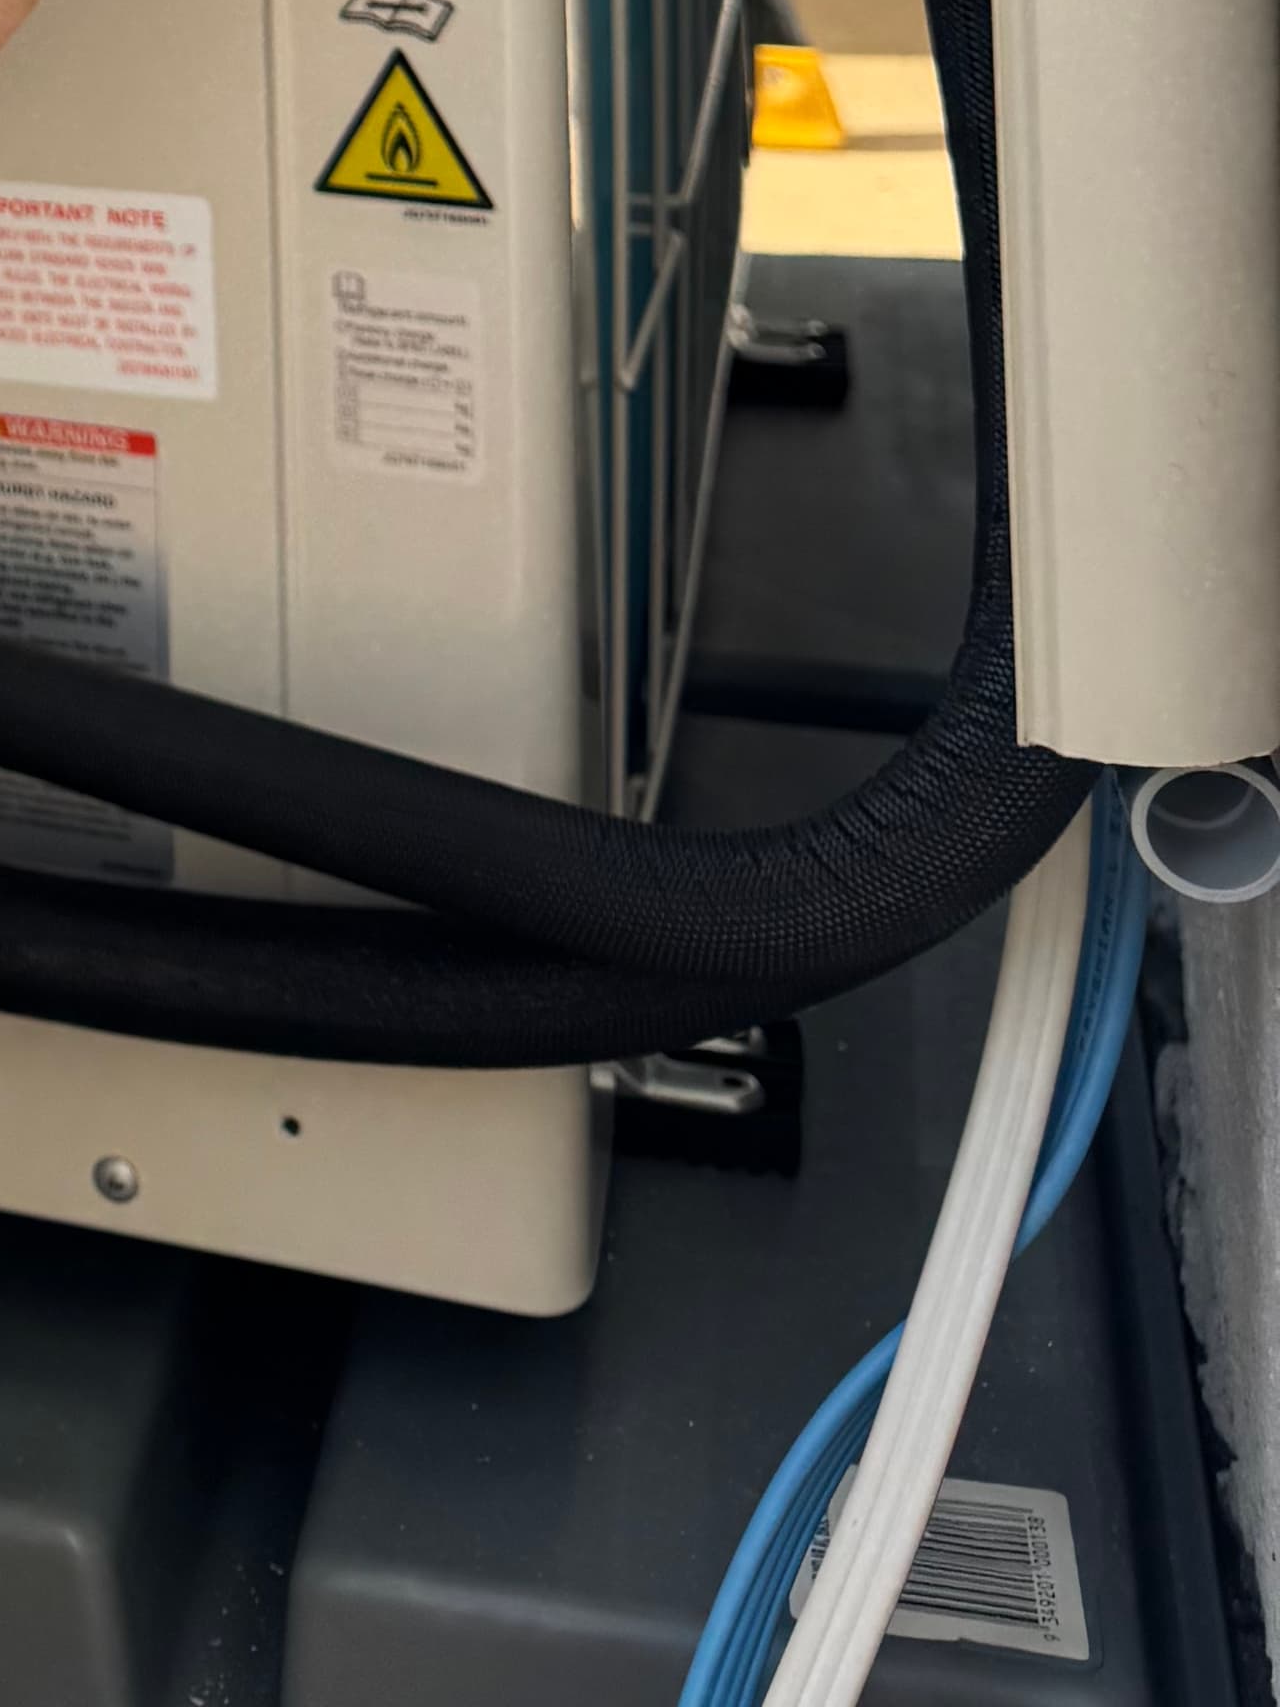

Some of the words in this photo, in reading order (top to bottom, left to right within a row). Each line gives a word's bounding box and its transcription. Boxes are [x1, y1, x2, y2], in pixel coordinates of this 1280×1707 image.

[107, 208, 168, 230] NOTE
[1027, 1516, 1051, 1568] 000138
[1037, 1573, 1059, 1627] 349201
[1044, 1633, 1061, 1643] 9
